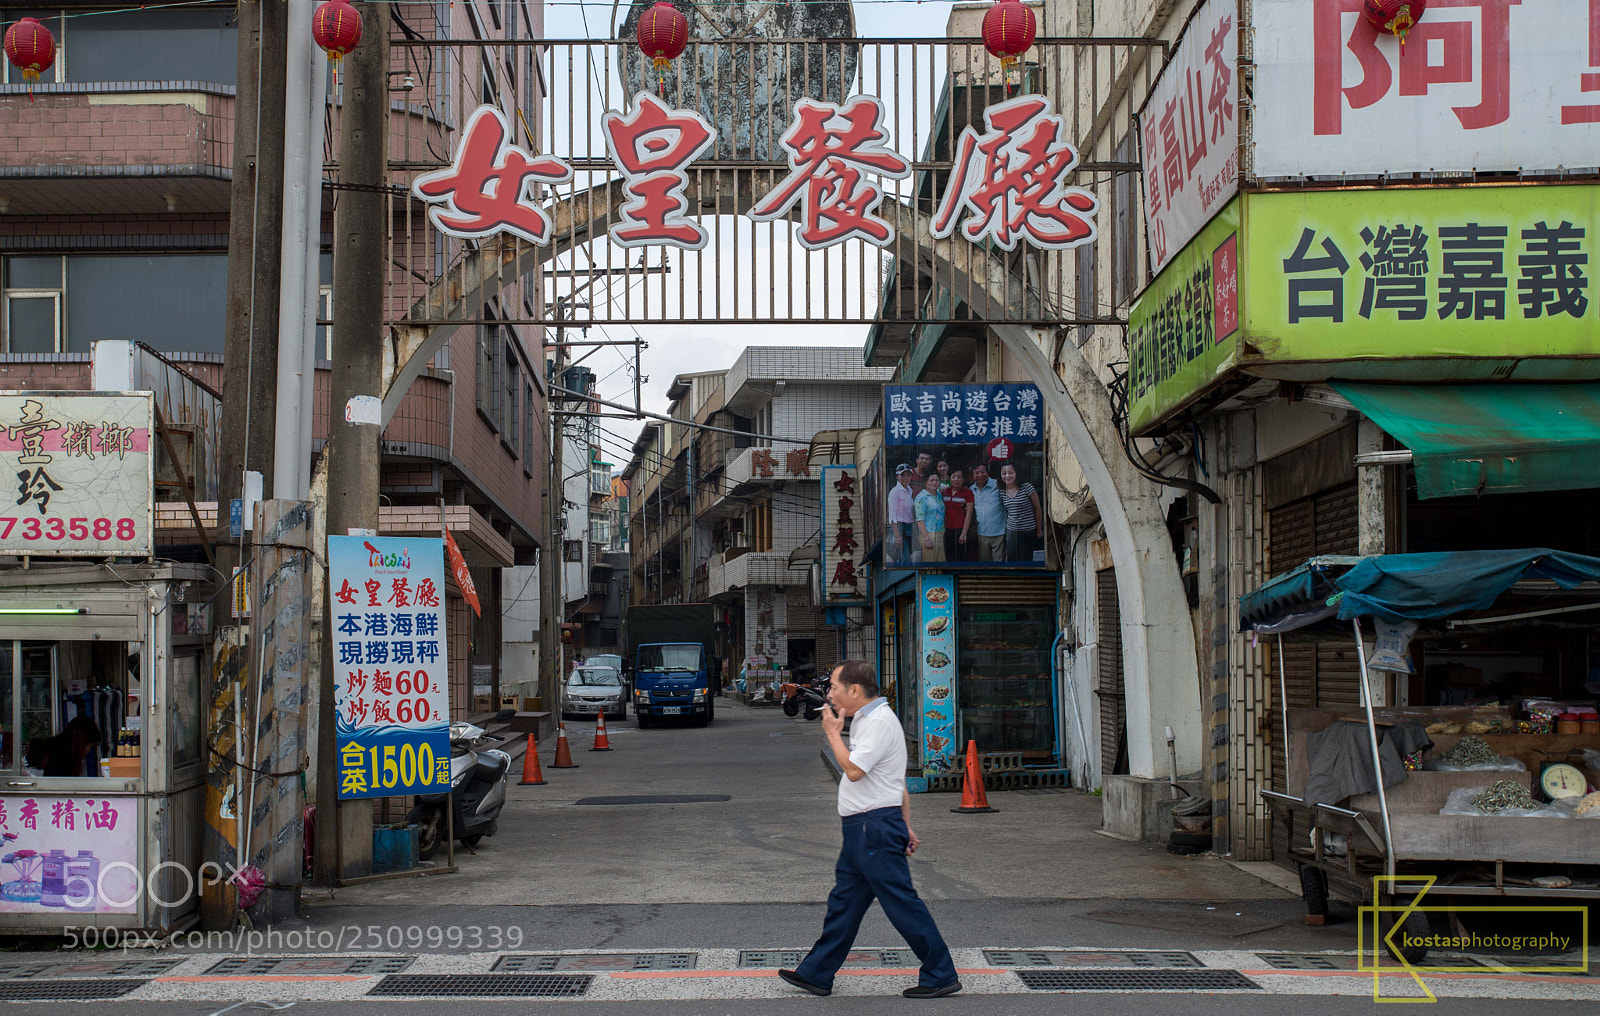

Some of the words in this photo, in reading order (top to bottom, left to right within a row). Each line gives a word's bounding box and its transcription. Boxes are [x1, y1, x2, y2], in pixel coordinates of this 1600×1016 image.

[1159, 14, 1233, 212] 高山茶
[414, 93, 1098, 250] 女皇餐廳
[1144, 113, 1166, 266] 阿里山
[1282, 220, 1589, 325] 台灣嘉義
[890, 388, 1039, 413] 歐吉尚遊台灣
[890, 415, 1039, 439] 特別採訪推薦
[16, 466, 64, 515] 玲
[831, 470, 860, 587] 女皇餐廳
[334, 577, 440, 608] 女皇餐廳
[337, 612, 439, 637] 本港海鮮
[338, 640, 440, 665] 現撈現秤
[369, 742, 435, 788] 1500
